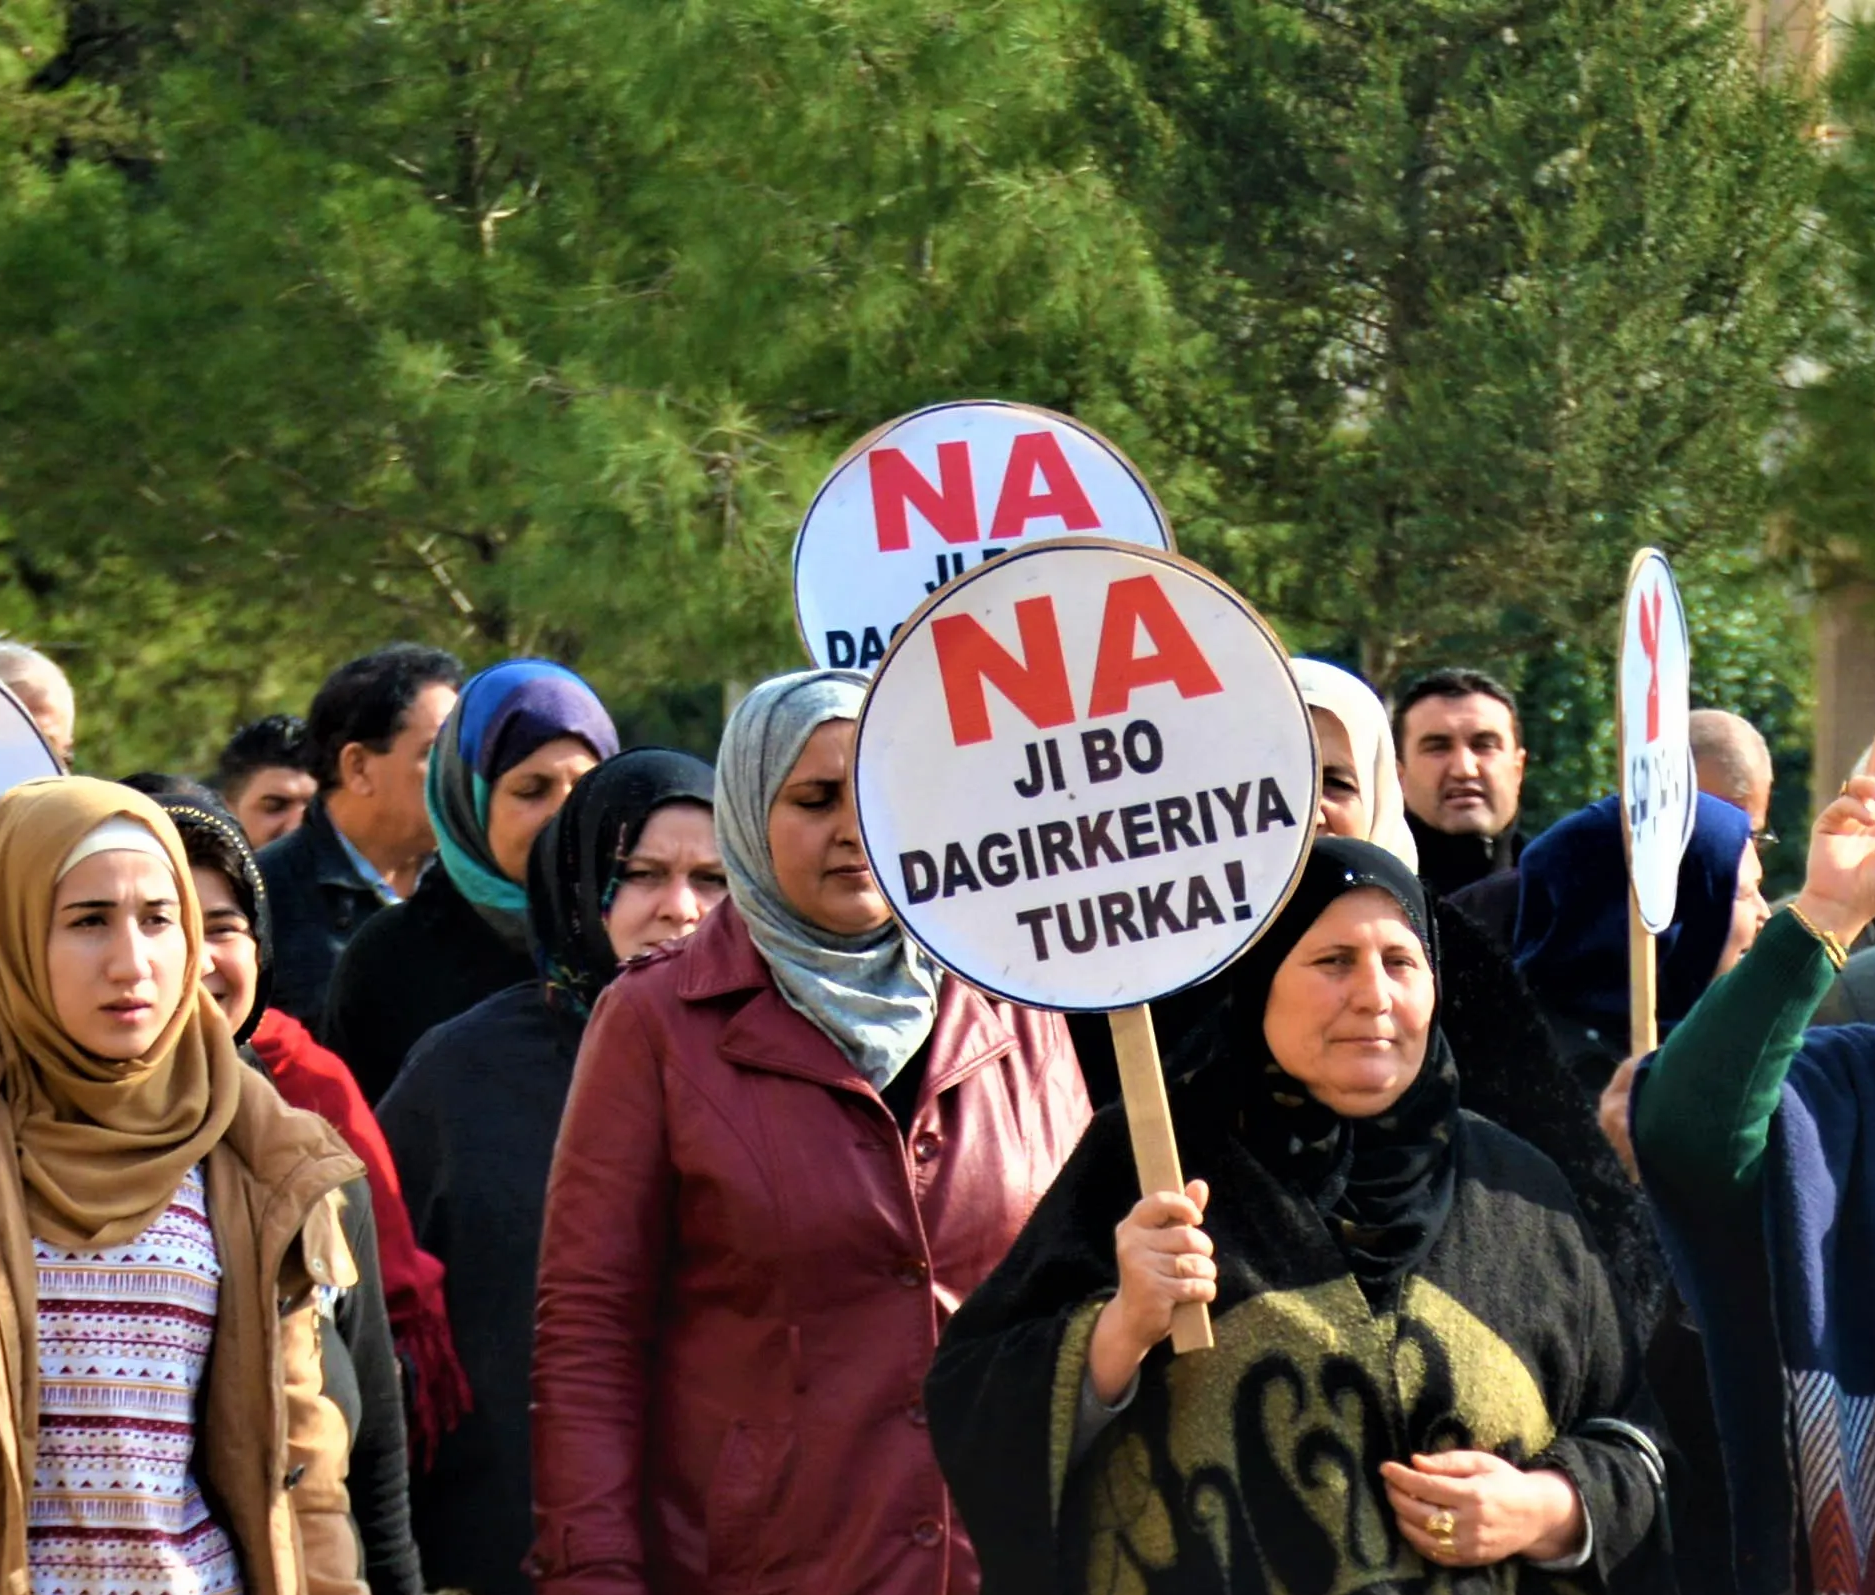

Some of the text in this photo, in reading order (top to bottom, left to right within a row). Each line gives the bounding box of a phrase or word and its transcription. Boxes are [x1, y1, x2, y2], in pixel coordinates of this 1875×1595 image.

[867, 431, 1102, 553] NA
[931, 574, 1225, 747] NA
[1014, 719, 1163, 799] JI BO
[899, 777, 1297, 906] DAGIRKERIYA
[1017, 860, 1254, 963] TURKA!
